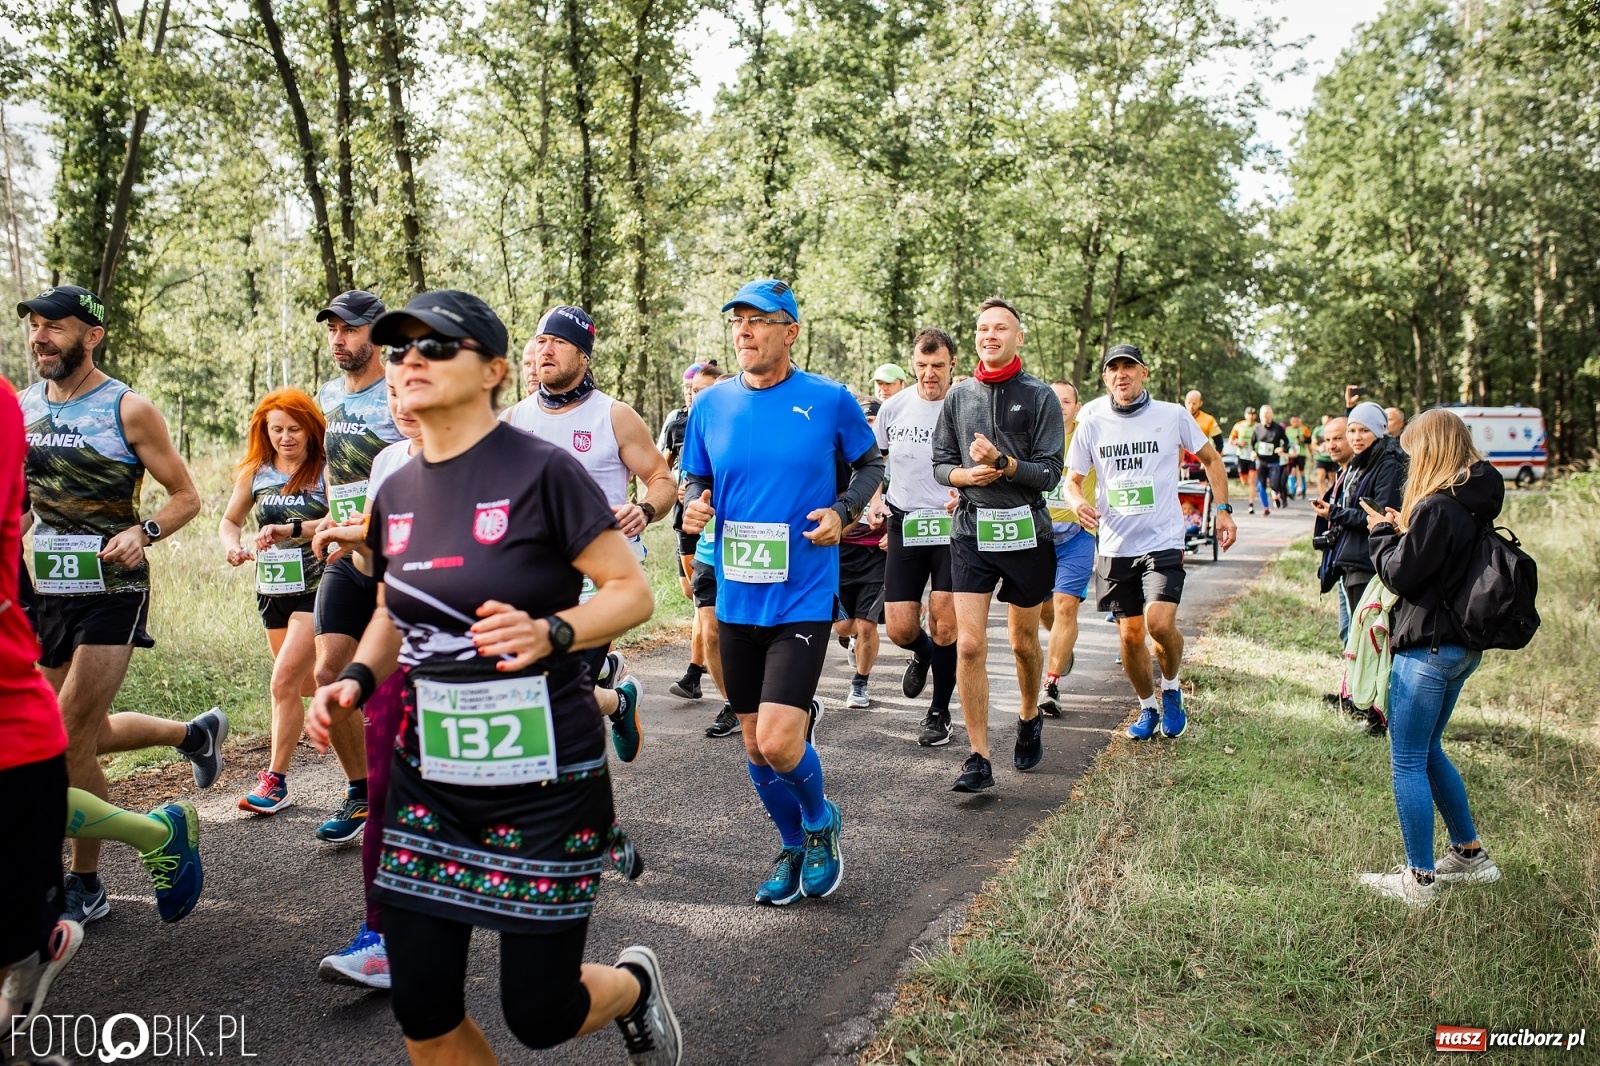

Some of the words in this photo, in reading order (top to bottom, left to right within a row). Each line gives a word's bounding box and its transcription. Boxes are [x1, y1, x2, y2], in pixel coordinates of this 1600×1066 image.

[325, 421, 367, 436] JANUSZ
[25, 433, 87, 448] FRANEK
[1099, 443, 1130, 459] NOWA
[1132, 441, 1159, 455] HUTA
[1115, 457, 1143, 471] TEAM
[261, 494, 306, 506] KINGA
[1117, 489, 1141, 506] 32
[917, 519, 940, 536] 56
[991, 522, 1019, 541] 39
[730, 541, 772, 568] 124
[47, 554, 79, 578] 28
[264, 564, 286, 583] 52
[440, 714, 524, 760] 132
